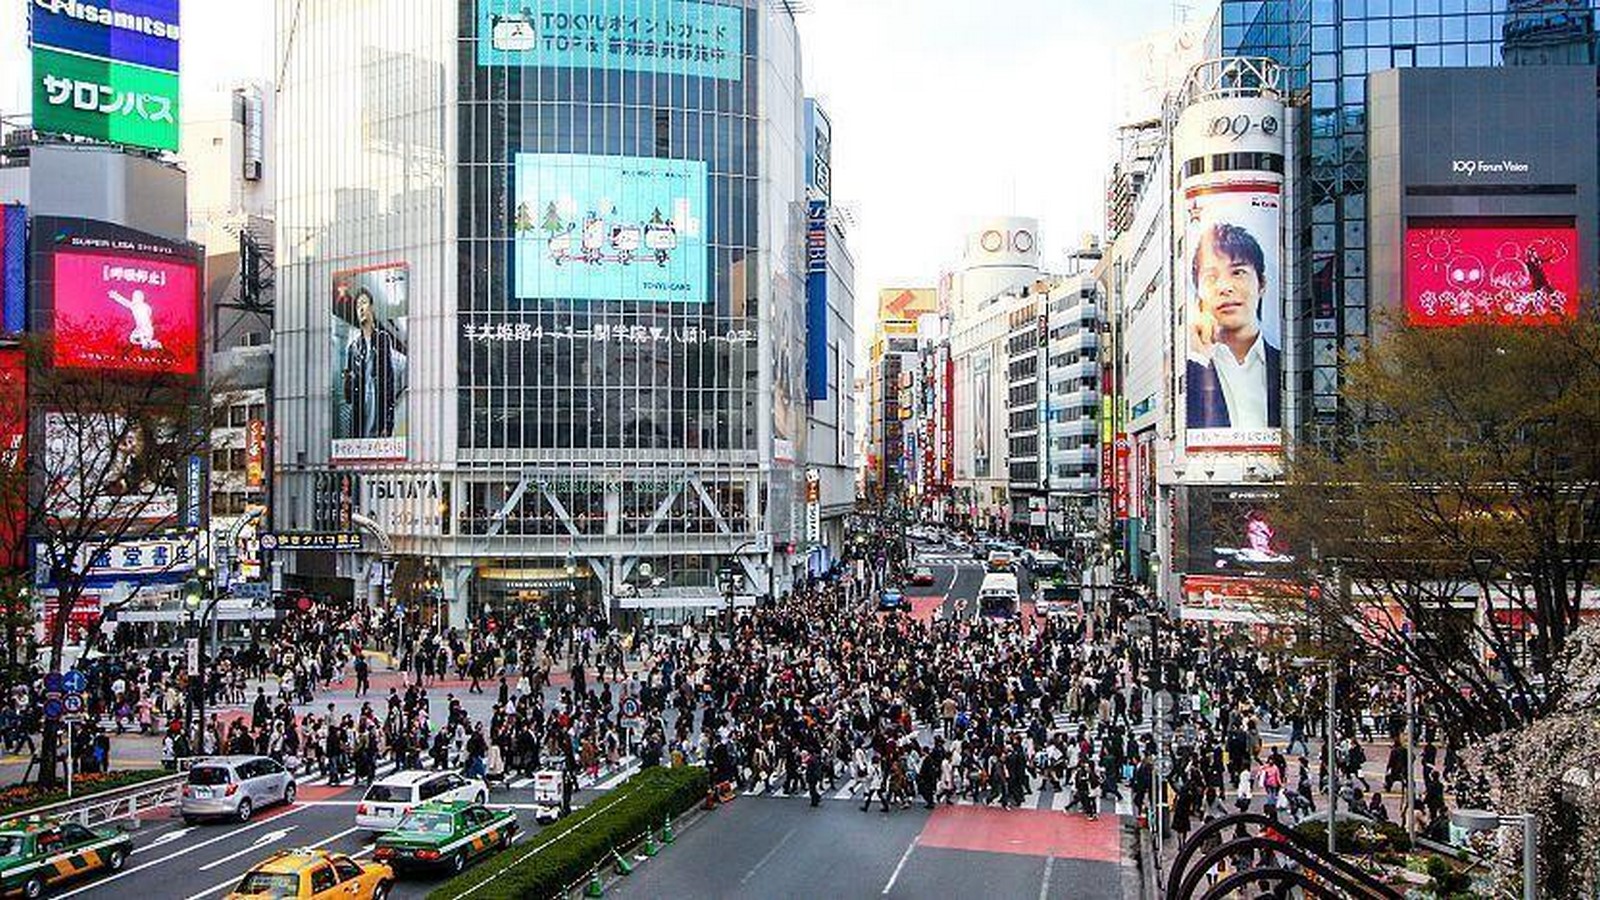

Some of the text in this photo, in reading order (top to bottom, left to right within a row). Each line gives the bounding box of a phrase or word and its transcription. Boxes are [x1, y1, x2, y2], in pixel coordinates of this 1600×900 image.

[43, 74, 174, 123] サロンパス
[1452, 160, 1477, 176] 109
